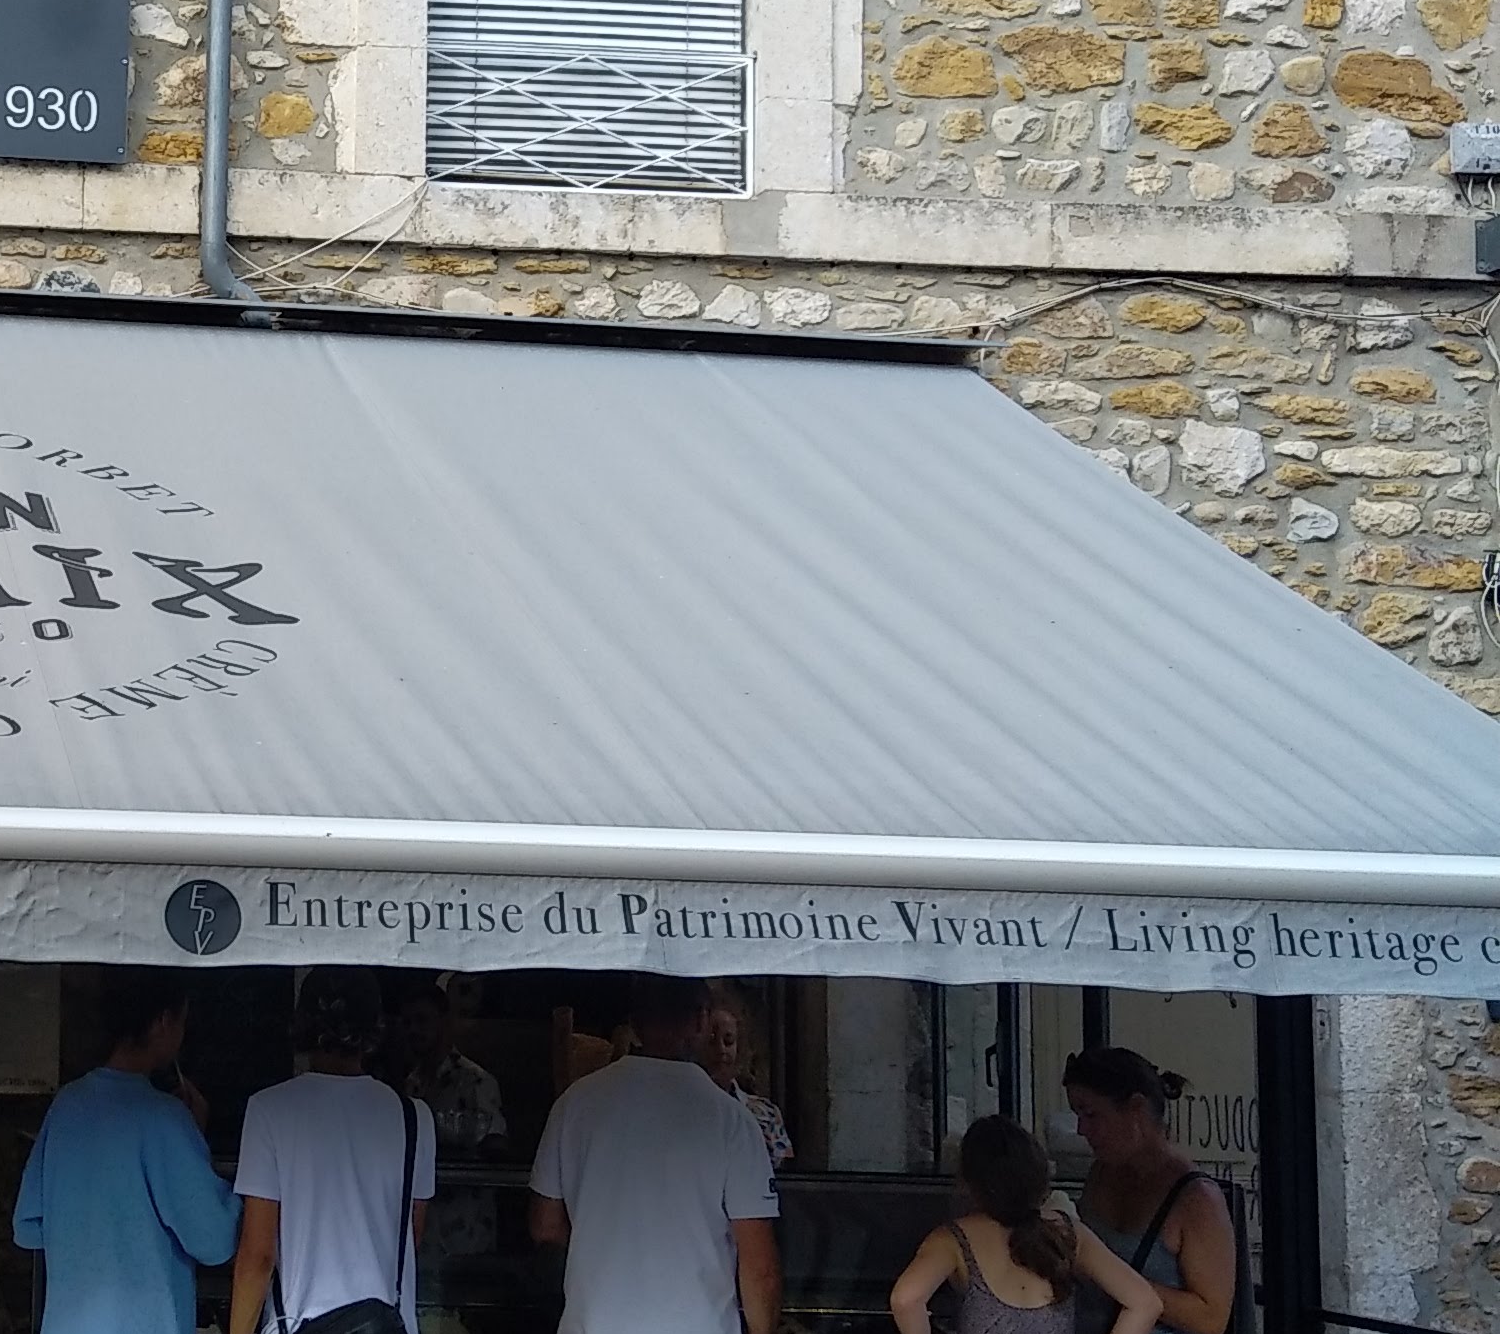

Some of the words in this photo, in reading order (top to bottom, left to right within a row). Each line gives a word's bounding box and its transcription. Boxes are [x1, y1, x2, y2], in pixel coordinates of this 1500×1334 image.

[48, 639, 278, 721] CRÈME
[264, 881, 524, 944] Entreprise
[543, 892, 600, 936] du
[617, 893, 881, 943] Patrimoine
[891, 900, 1048, 949] Vivant
[1064, 905, 1084, 951] /
[1102, 907, 1256, 969] Living
[1269, 912, 1464, 976] heritage
